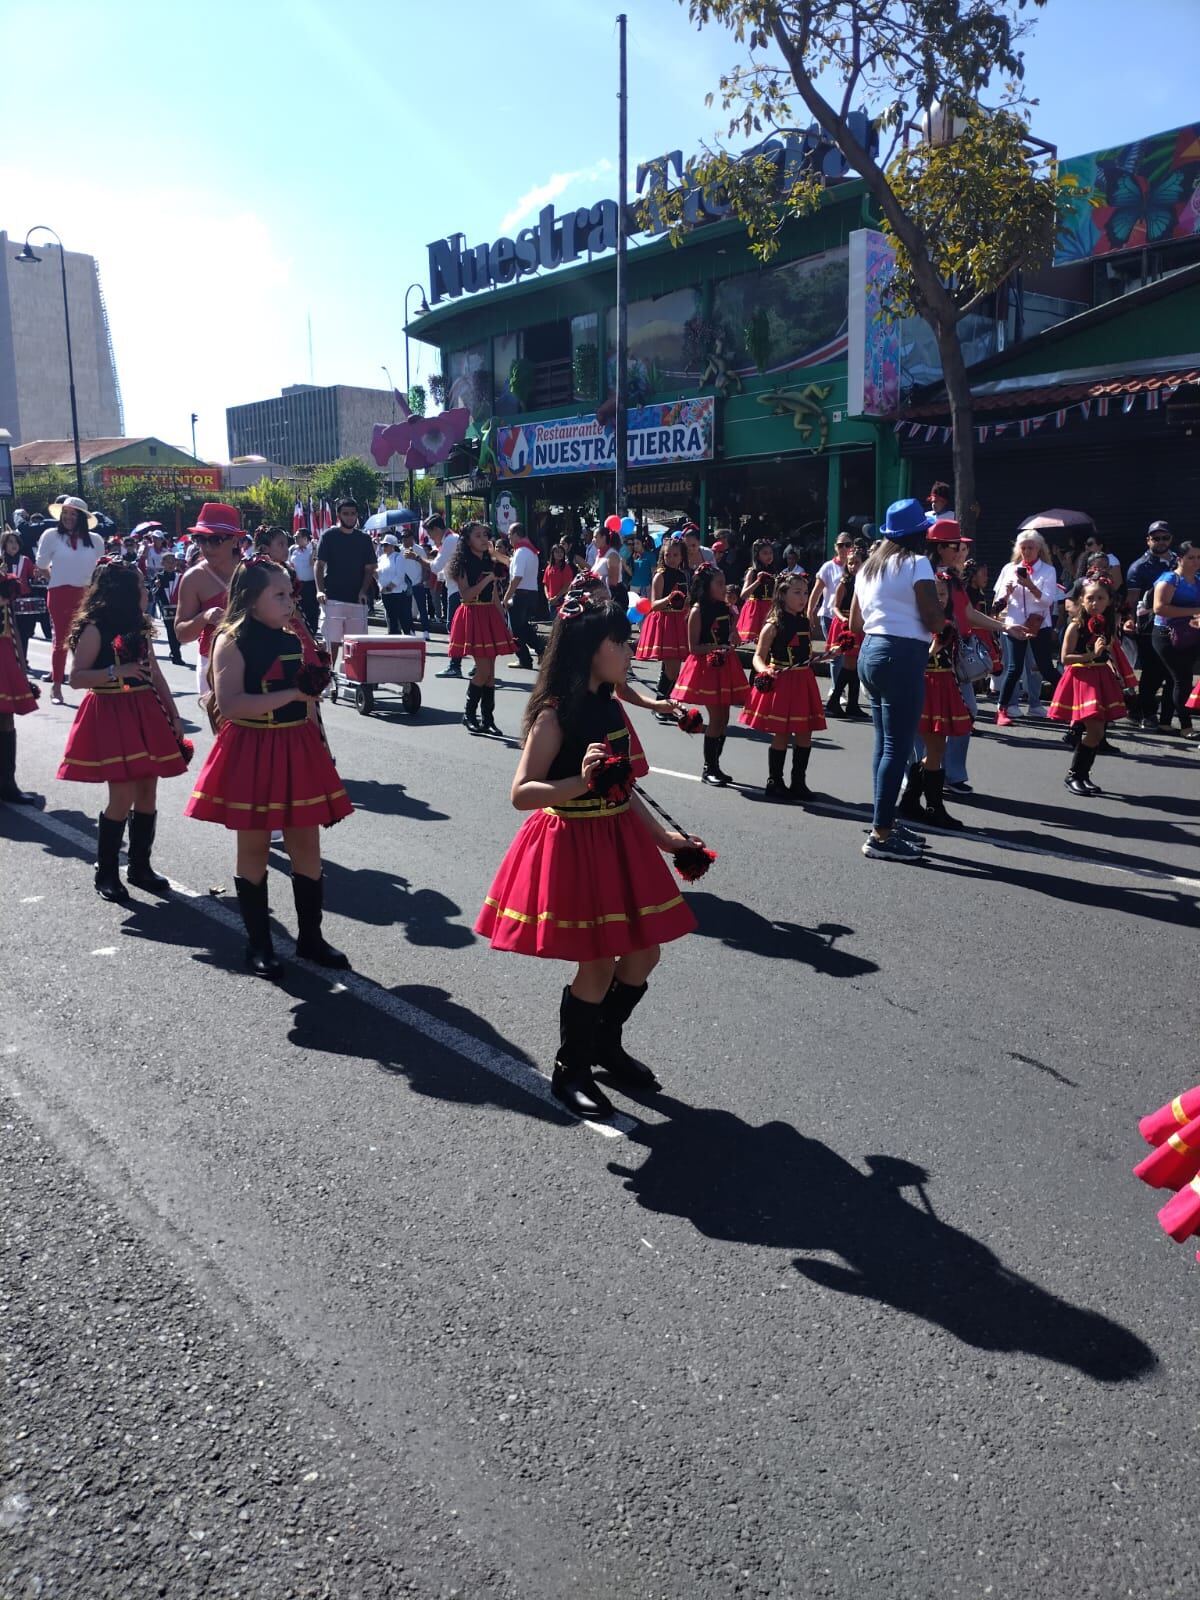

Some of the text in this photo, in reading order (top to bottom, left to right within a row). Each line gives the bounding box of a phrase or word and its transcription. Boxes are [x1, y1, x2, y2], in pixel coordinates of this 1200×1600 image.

[427, 198, 620, 305] Nuestra
[535, 426, 702, 466] NUESTRA TIERRA
[536, 424, 604, 442] Restaurante
[625, 479, 692, 495] estaurante
